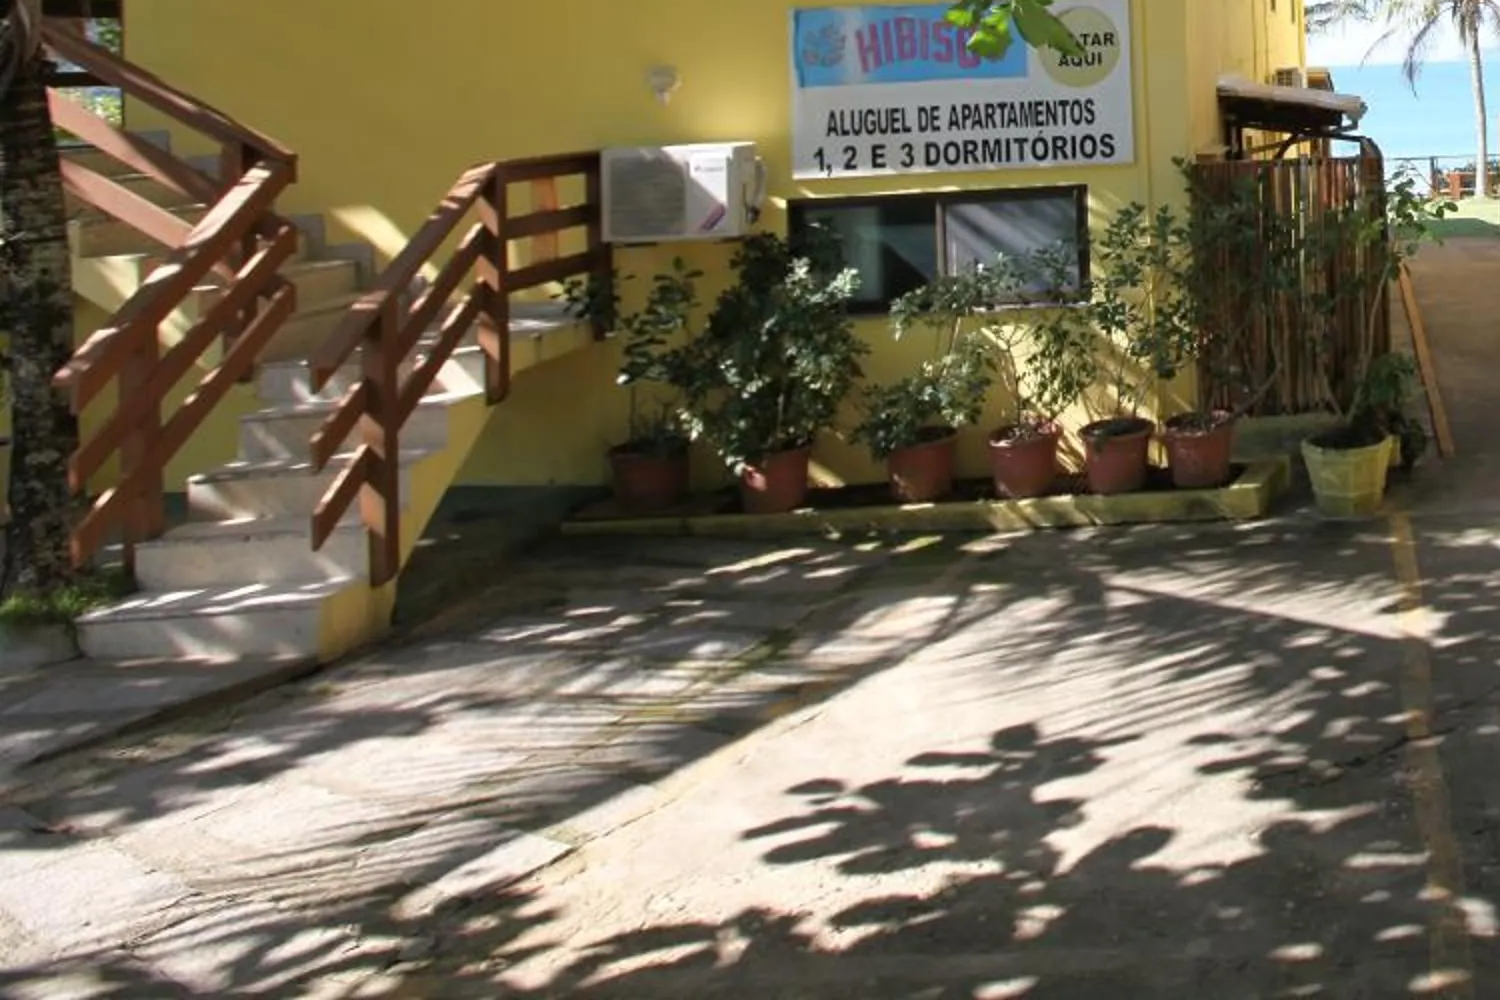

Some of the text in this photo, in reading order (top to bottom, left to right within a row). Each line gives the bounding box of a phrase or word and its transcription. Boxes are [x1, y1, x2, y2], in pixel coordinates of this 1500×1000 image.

[855, 16, 997, 73] HIBISC
[826, 98, 1096, 137] ALUGUEL DE APARTAMENTOS
[813, 130, 1116, 177] 1, 2 E 3 DORMITÓRIOS
